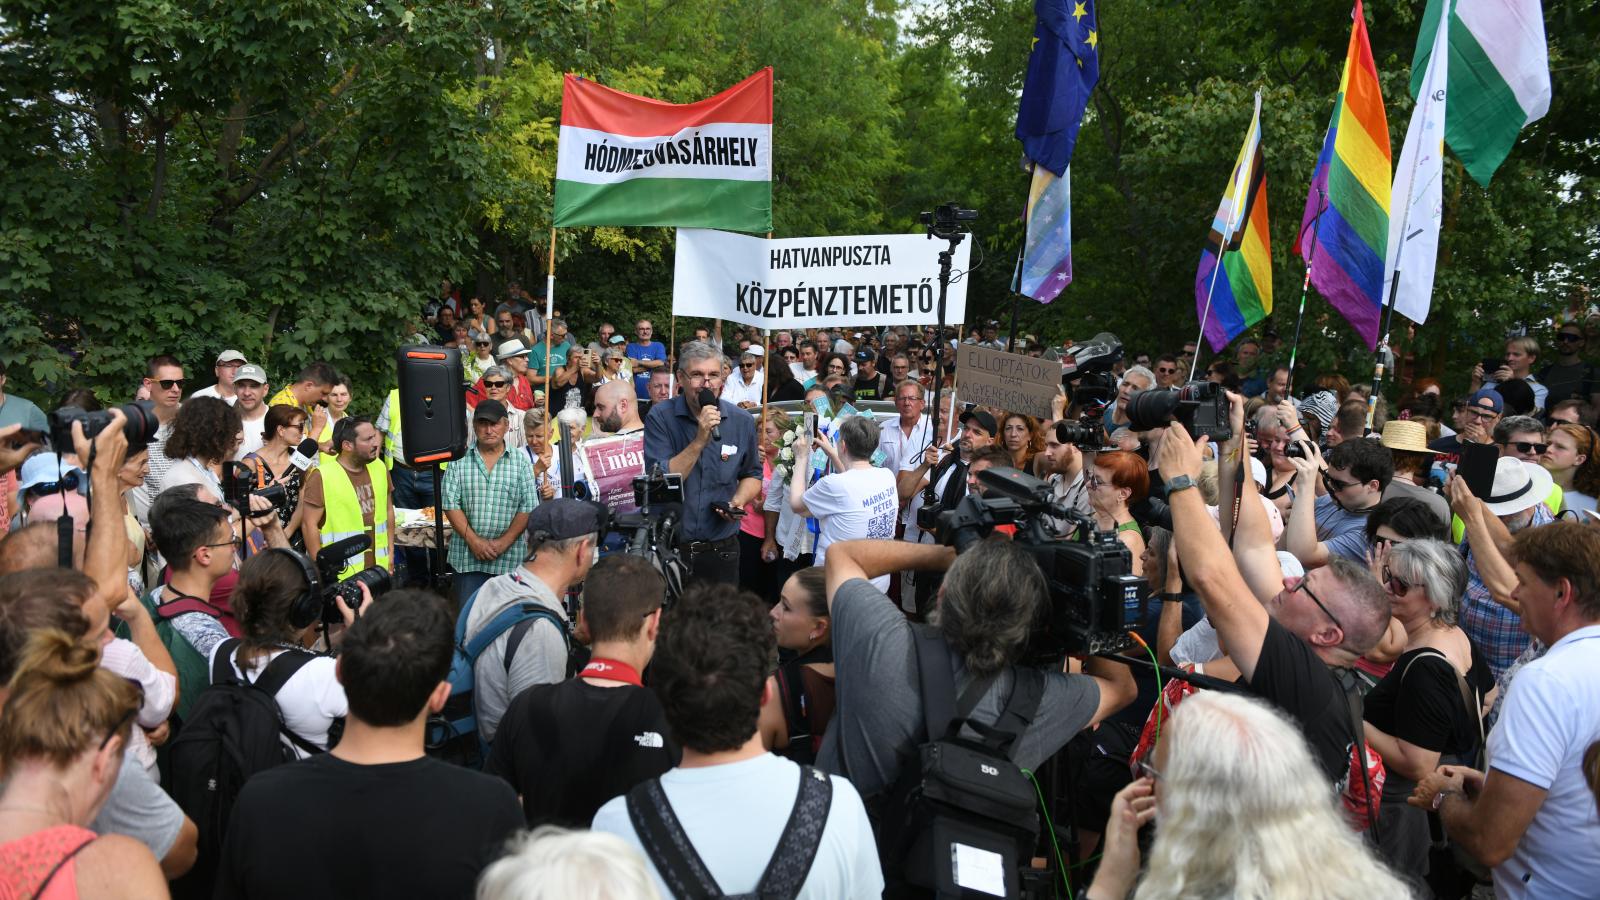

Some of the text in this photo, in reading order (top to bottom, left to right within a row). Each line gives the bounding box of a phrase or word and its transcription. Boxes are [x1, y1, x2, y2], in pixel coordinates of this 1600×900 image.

[770, 244, 891, 269] HATVANPUSZTA
[736, 277, 933, 318] KÖZPÉNZTEMETŐ
[961, 382, 969, 392] A
